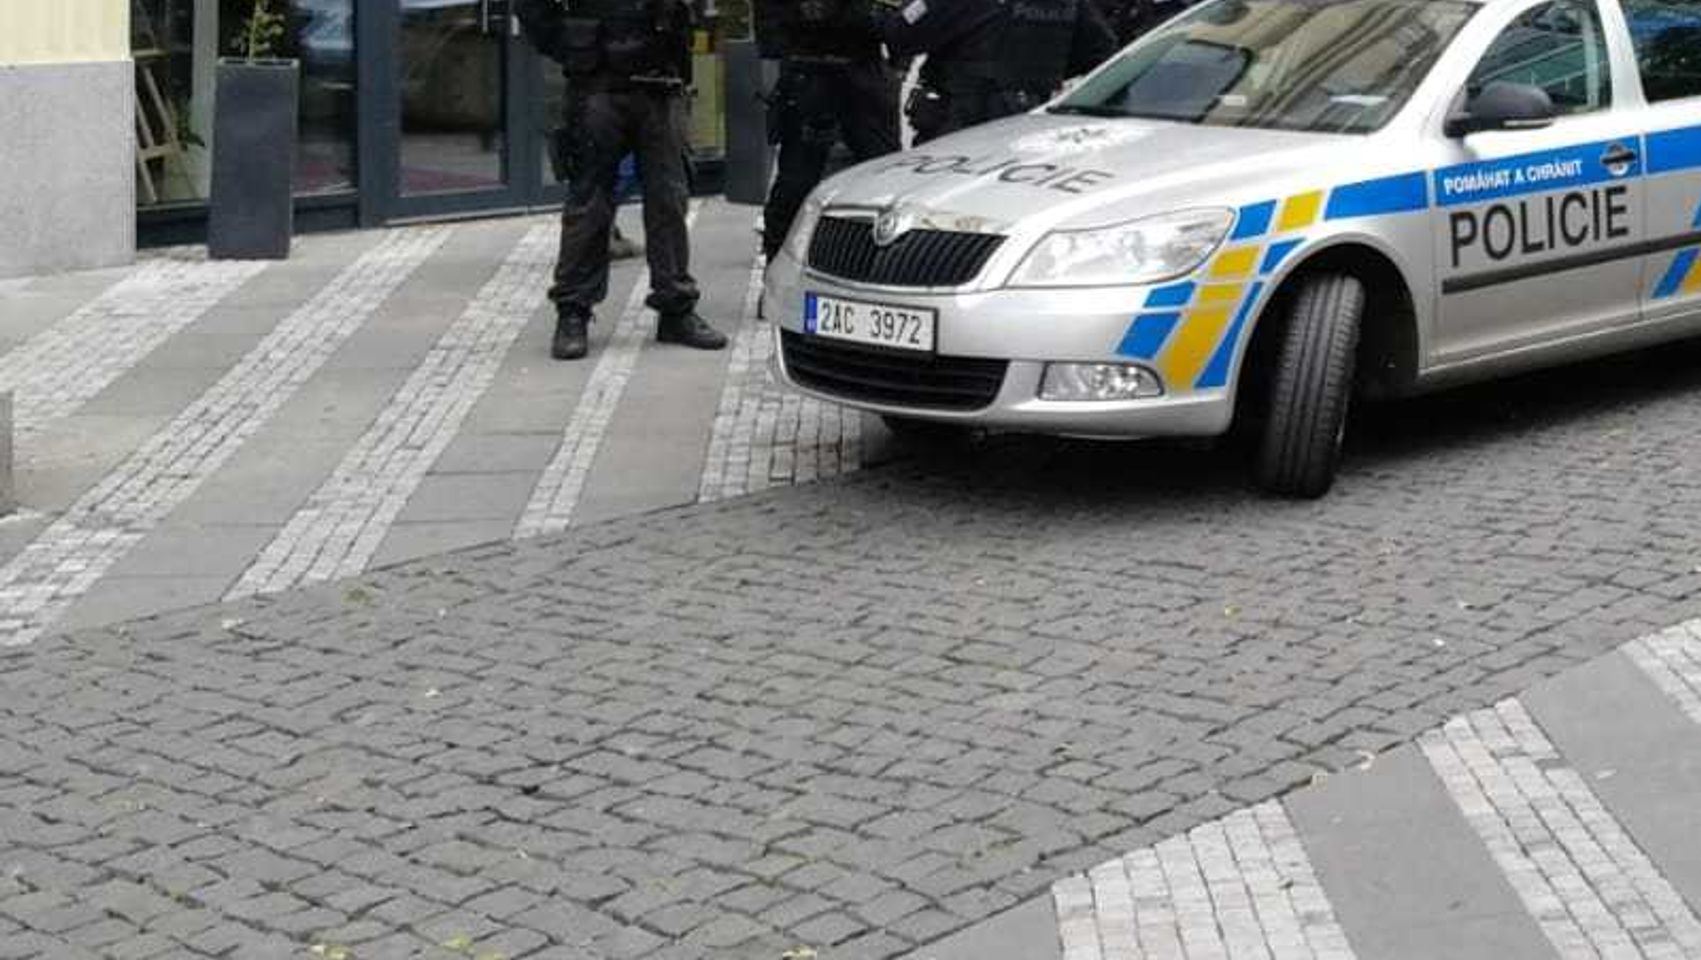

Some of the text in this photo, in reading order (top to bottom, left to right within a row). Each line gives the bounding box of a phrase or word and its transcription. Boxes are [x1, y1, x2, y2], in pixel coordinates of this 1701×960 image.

[876, 154, 1116, 194] POLICIE
[1443, 158, 1583, 196] POMÁHAT A CHRÁNIT
[1449, 185, 1629, 268] POLICIE
[820, 300, 921, 344] 2AC 3972
